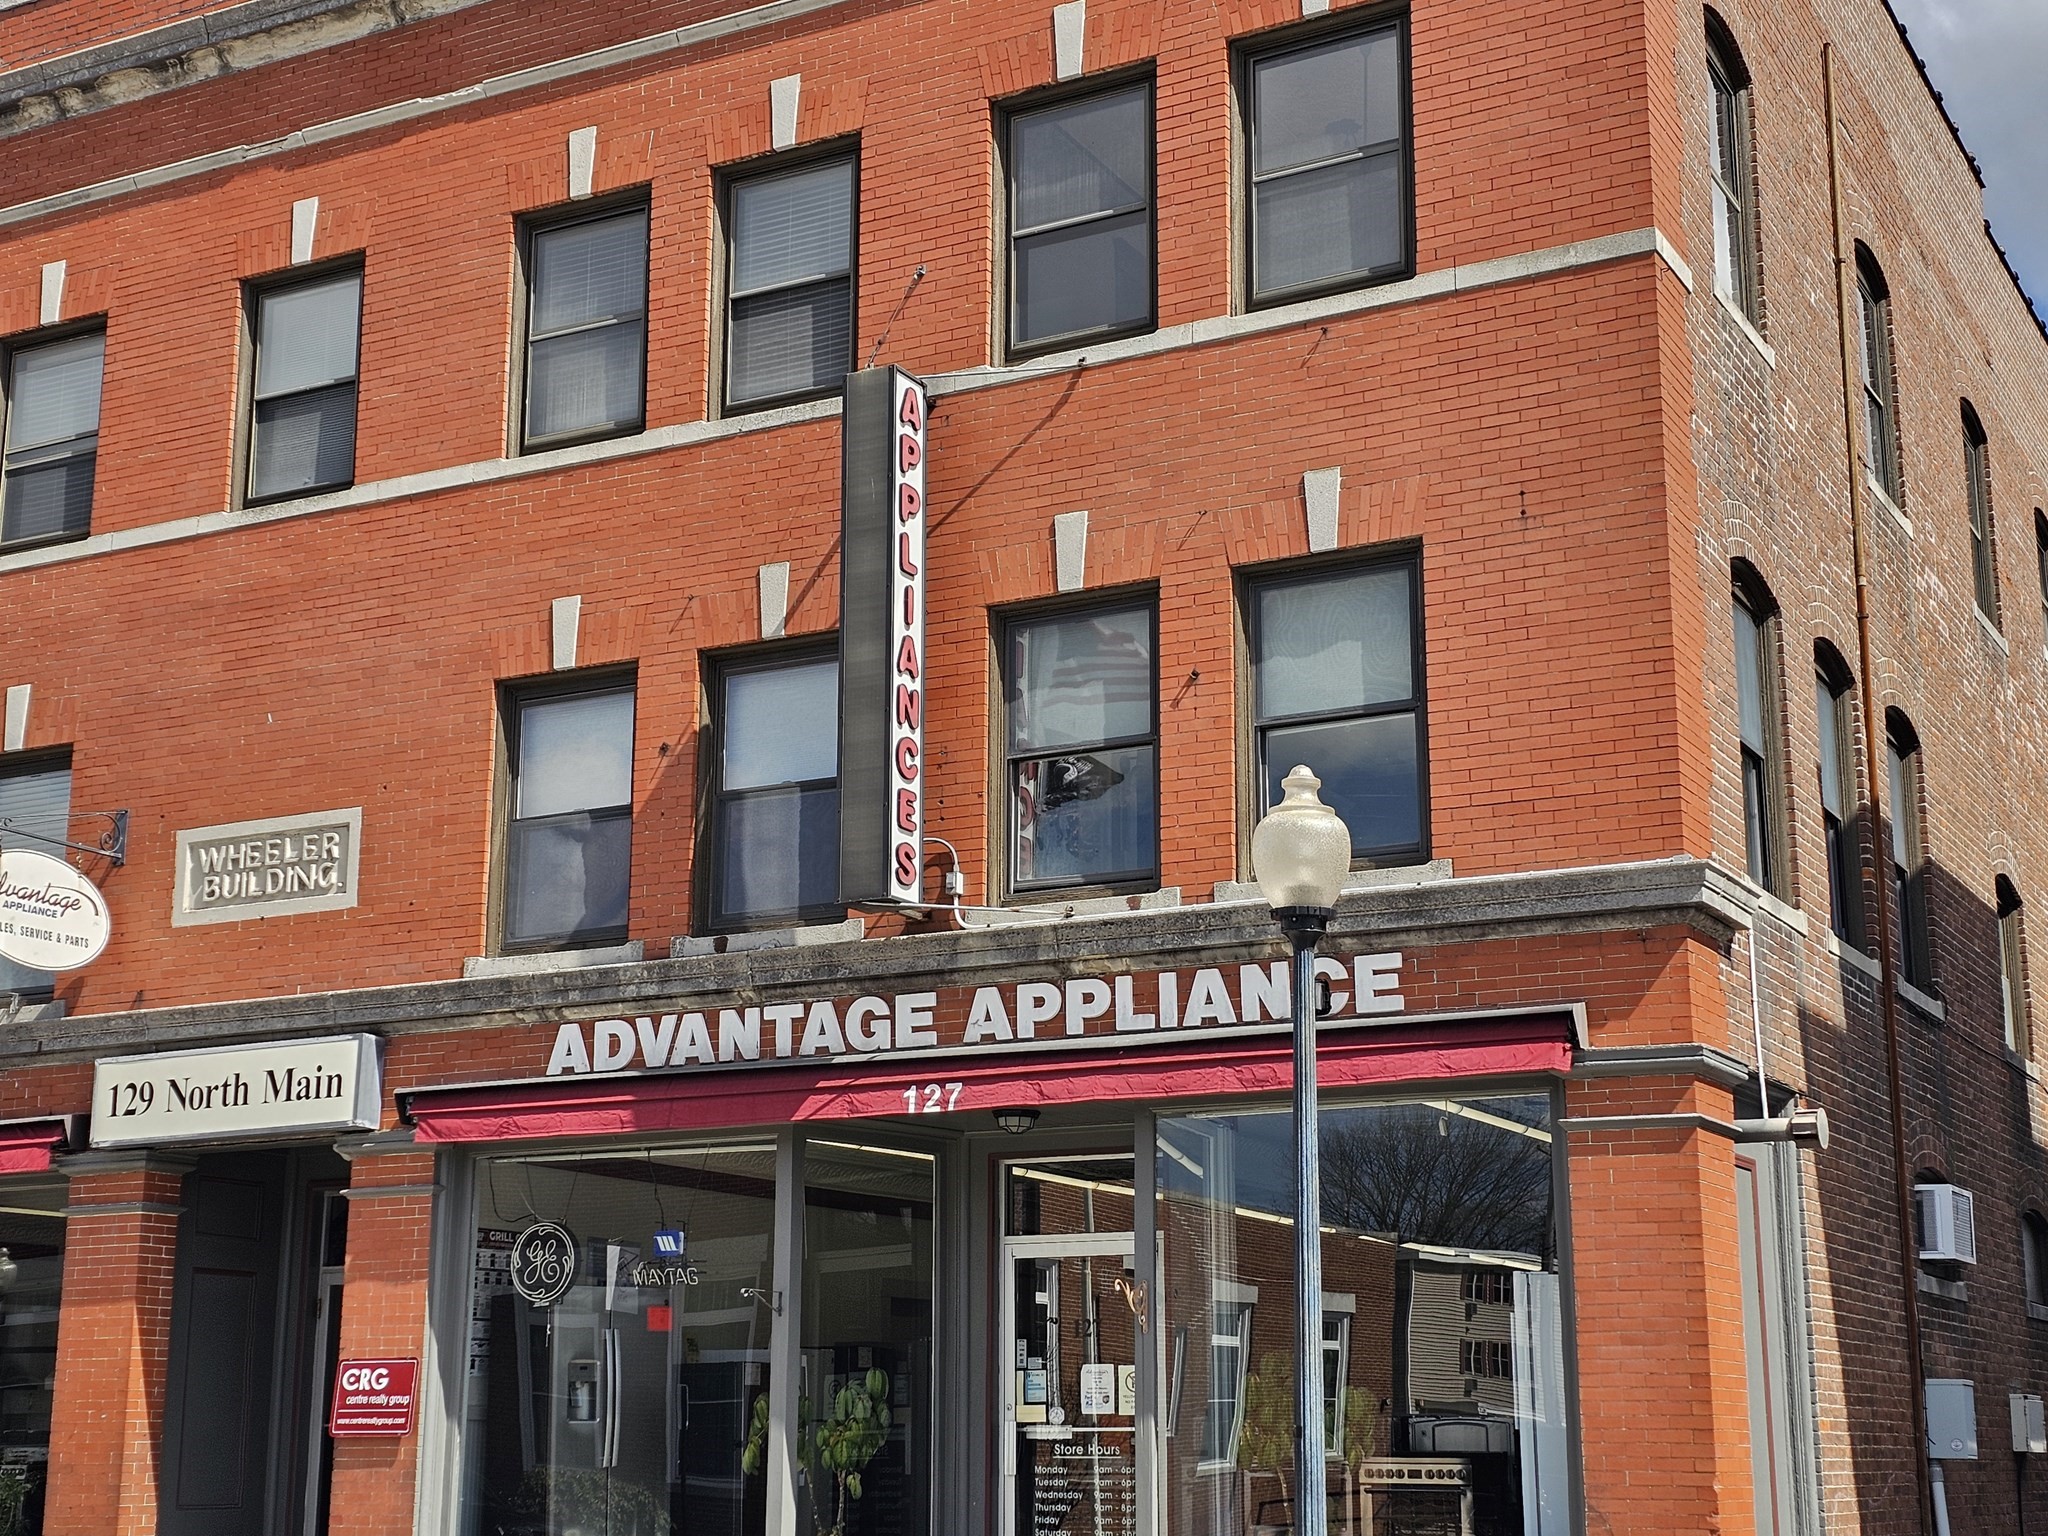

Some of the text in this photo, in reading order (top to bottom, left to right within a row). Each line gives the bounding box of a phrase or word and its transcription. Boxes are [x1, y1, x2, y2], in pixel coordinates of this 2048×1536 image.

[895, 387, 921, 886] APPLIANCES
[199, 832, 340, 873] WHEELER
[2, 900, 58, 919] APPLIANCE
[20, 925, 53, 941] SERVICE
[56, 932, 61, 943] &
[65, 934, 89, 948] PARTS
[546, 952, 1405, 1076] ADVANTAGE APPLIANCE
[106, 1065, 343, 1118] 129 North Main
[903, 1082, 963, 1114] 127
[489, 1231, 514, 1242] GRILL
[632, 1267, 699, 1286] MAYTAG
[342, 1367, 389, 1391] CRG
[346, 1394, 410, 1406] centre realty group
[1054, 1444, 1120, 1455] Store Hours
[1034, 1466, 1068, 1476] Monday
[1034, 1478, 1069, 1488] Tuesday
[1034, 1491, 1083, 1501] Wednesday
[1034, 1504, 1071, 1514] Thursday
[1034, 1516, 1060, 1526] Friday
